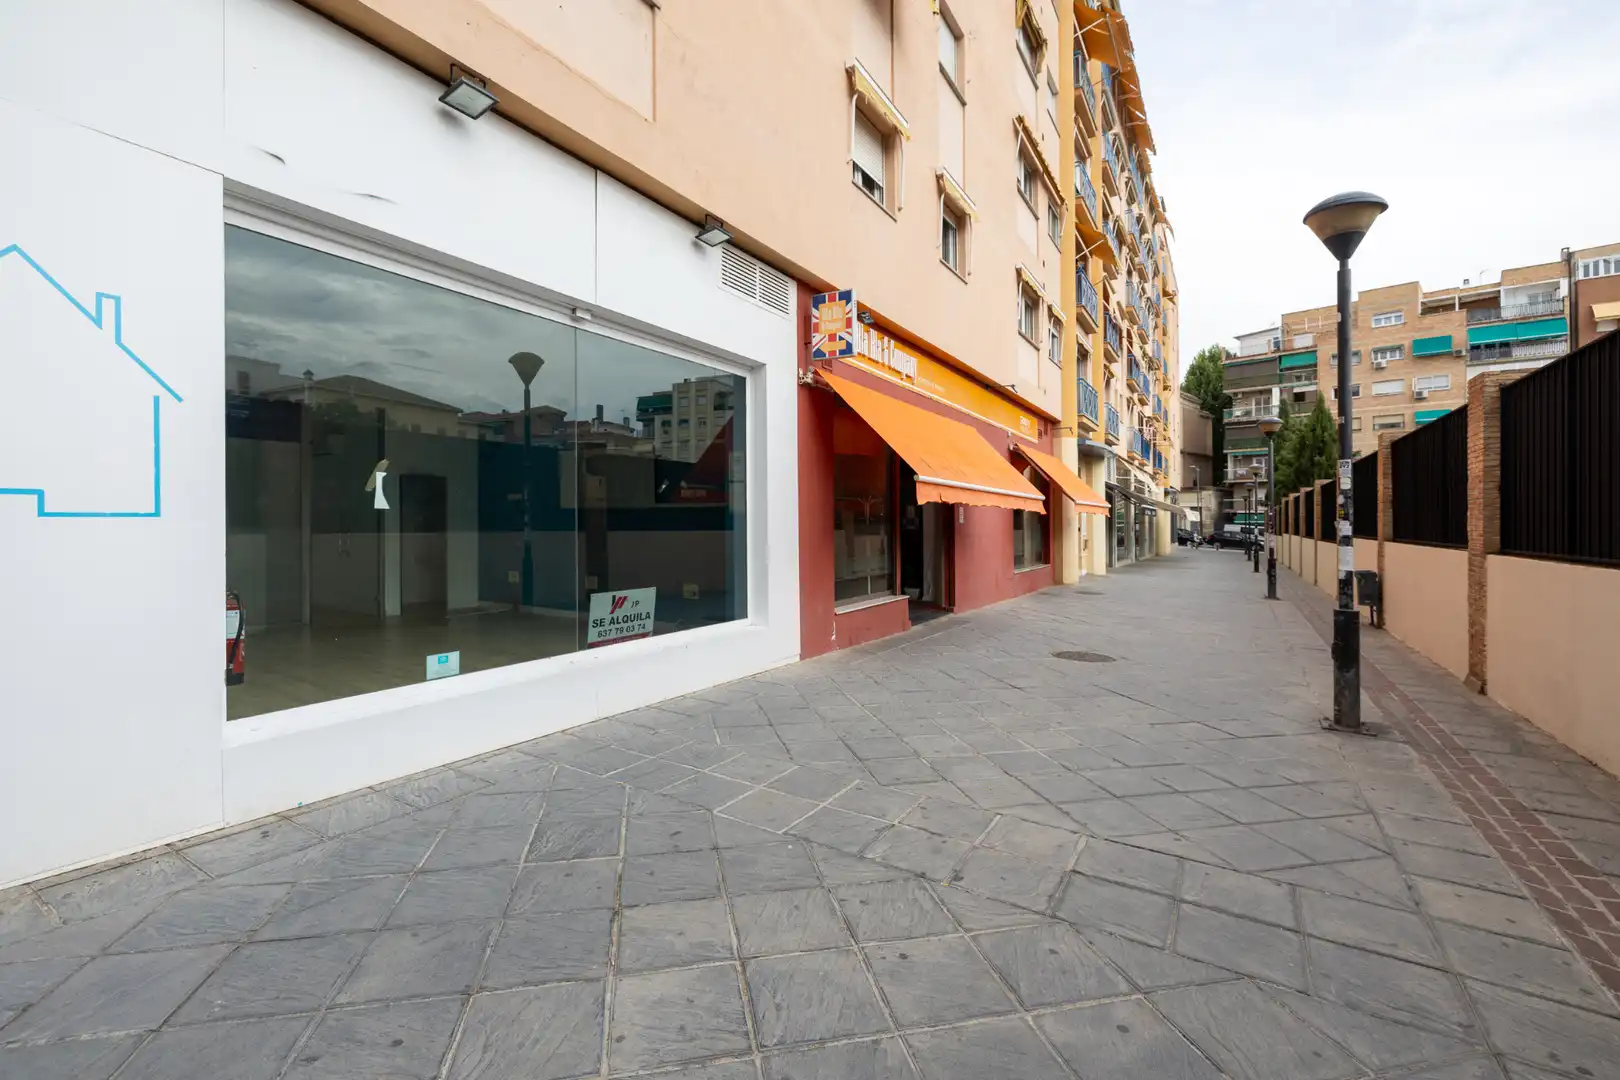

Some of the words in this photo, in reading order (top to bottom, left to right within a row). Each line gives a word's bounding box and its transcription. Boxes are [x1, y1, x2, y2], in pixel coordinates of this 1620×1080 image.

[870, 328, 882, 363] Bla
[591, 617, 606, 628] SE
[608, 611, 651, 626] ALQUILA
[597, 628, 612, 638] 637
[614, 626, 624, 635] 79
[625, 625, 635, 633] 03
[636, 623, 646, 631] 74
